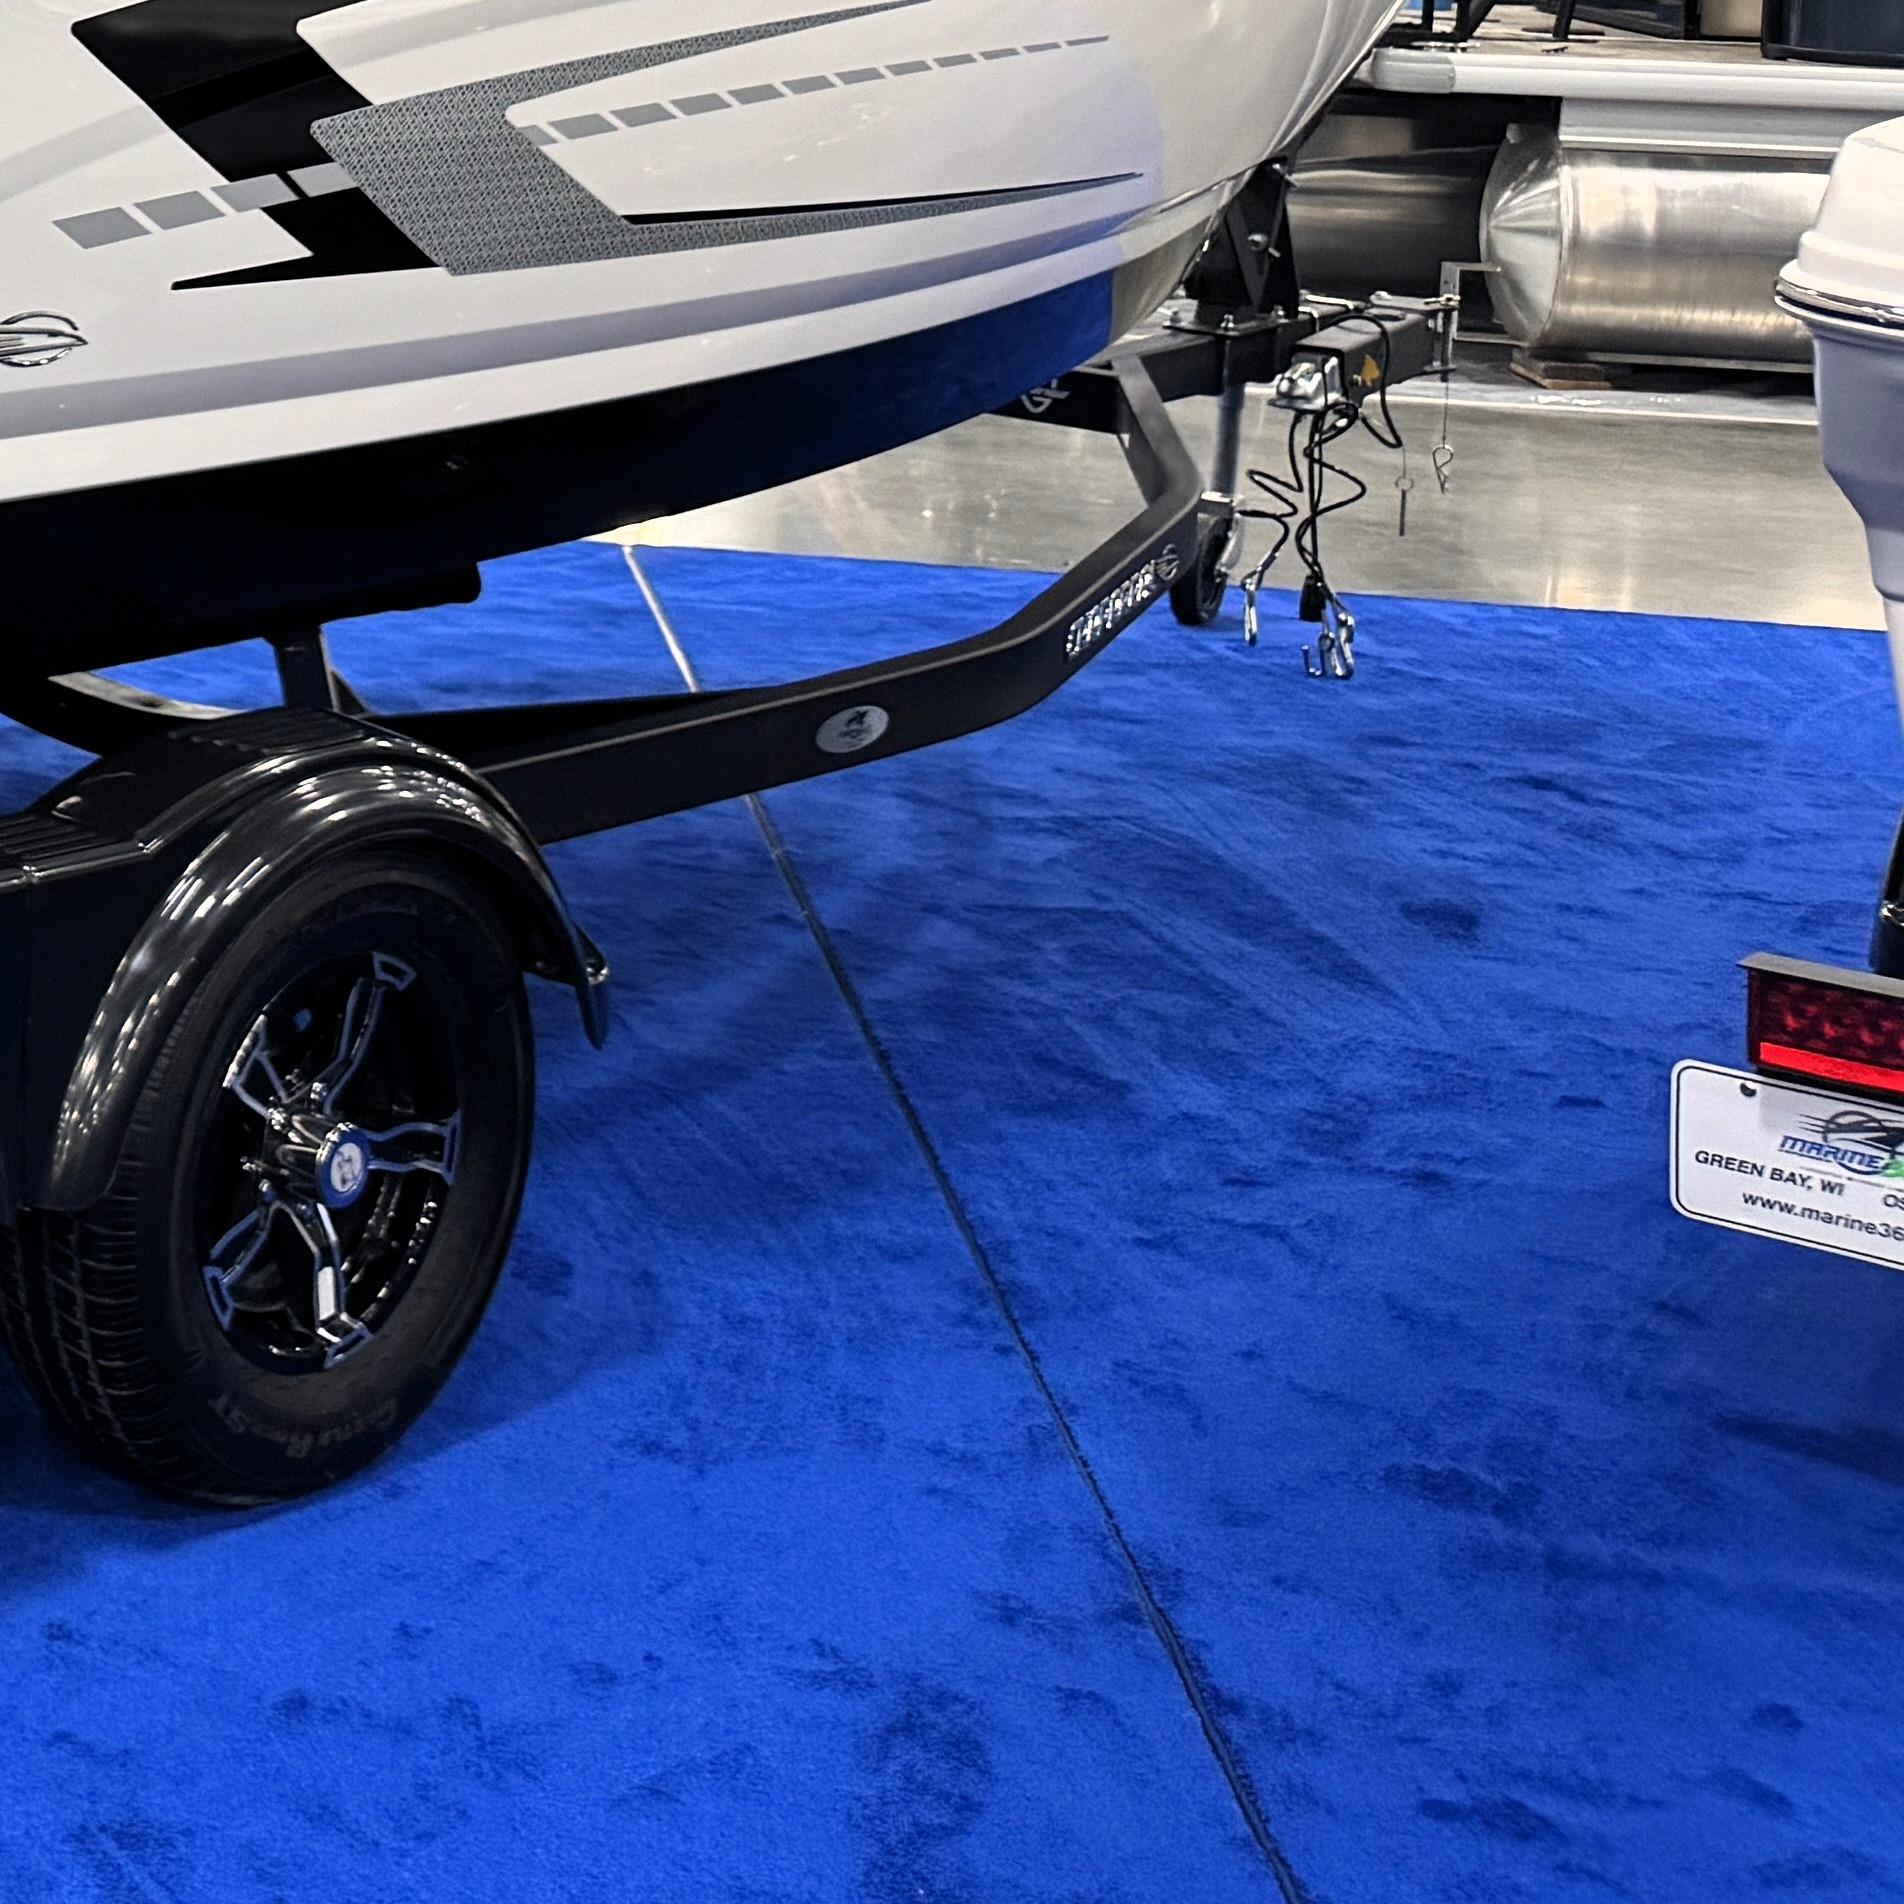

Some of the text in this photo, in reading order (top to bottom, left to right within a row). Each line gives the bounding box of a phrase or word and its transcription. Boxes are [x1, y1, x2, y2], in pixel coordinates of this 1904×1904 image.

[1694, 1150, 1765, 1177] GREEN
[1769, 1167, 1813, 1191] BAY,
[1819, 1178, 1846, 1197] WI
